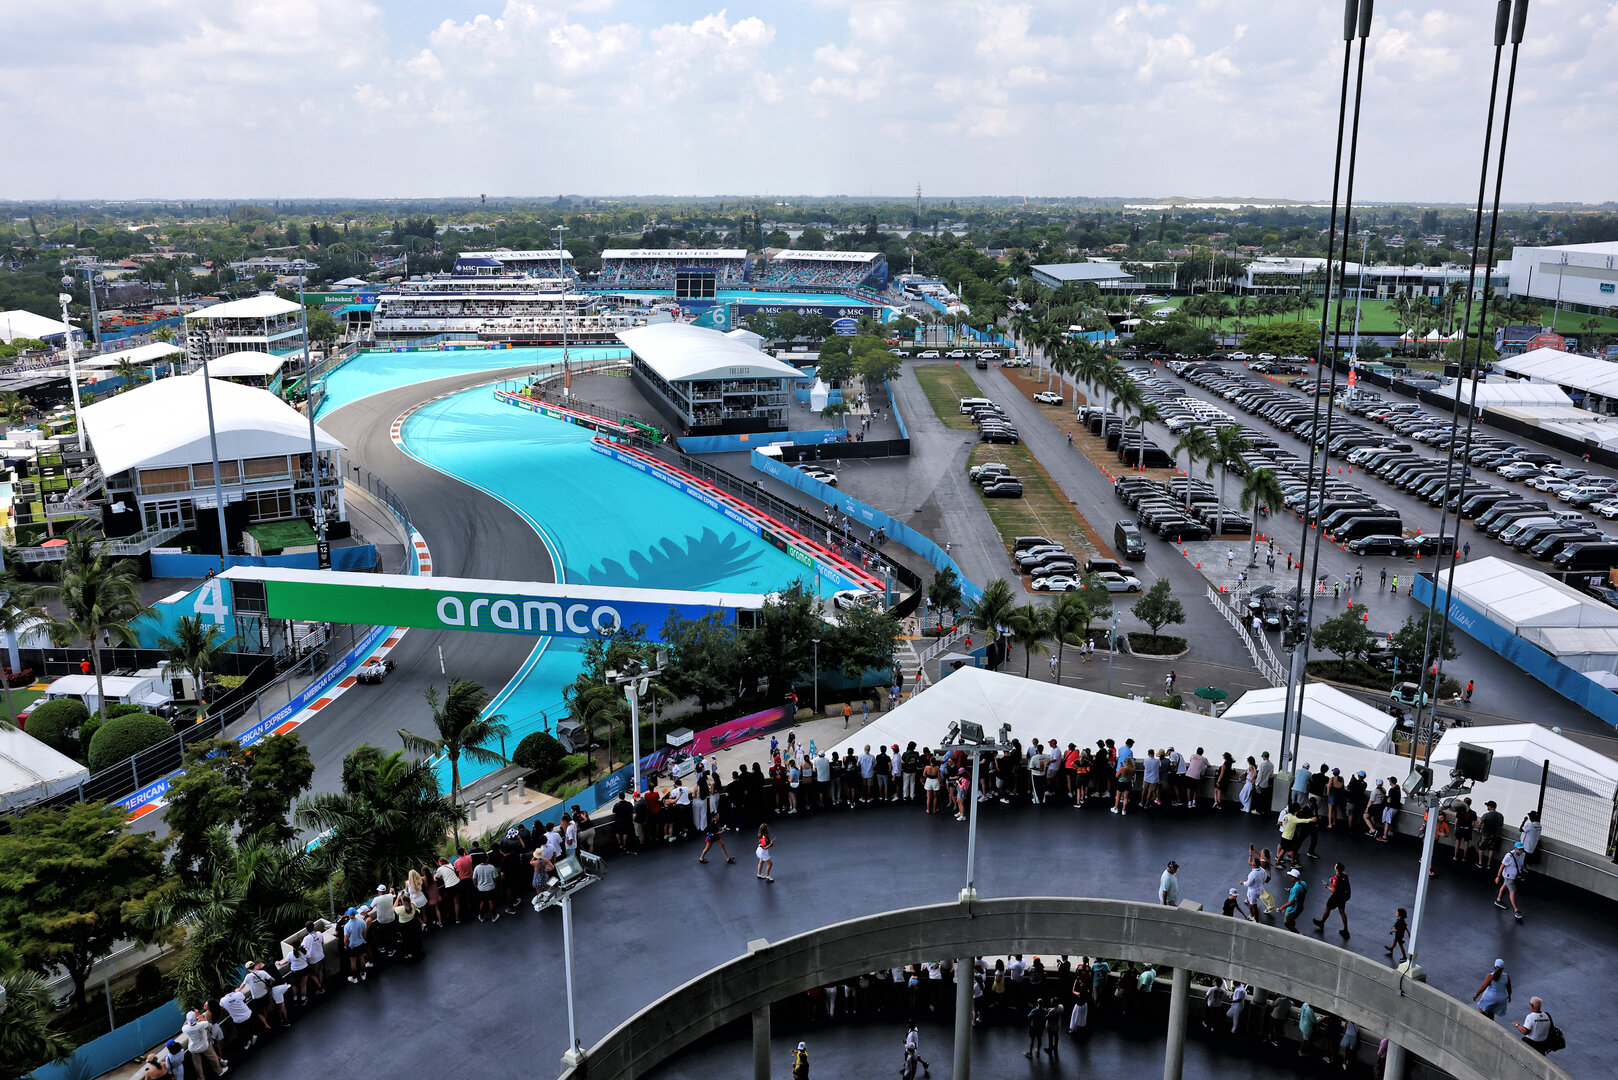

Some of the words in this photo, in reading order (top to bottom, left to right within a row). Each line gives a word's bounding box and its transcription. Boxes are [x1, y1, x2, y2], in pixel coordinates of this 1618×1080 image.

[713, 308, 726, 324] 6
[724, 508, 742, 524] AMERICAN
[742, 518, 759, 533] EXPRESS
[789, 547, 812, 567] aramco
[817, 564, 840, 584] aramco
[194, 579, 229, 624] 4
[436, 596, 621, 635] aramco
[303, 676, 328, 703] AMERICAN
[327, 660, 347, 682] EXPRESS
[240, 724, 264, 746] ERICAN
[264, 705, 293, 731] EXPRESS
[606, 775, 620, 788] MIA
[125, 782, 165, 810] MERICAN
